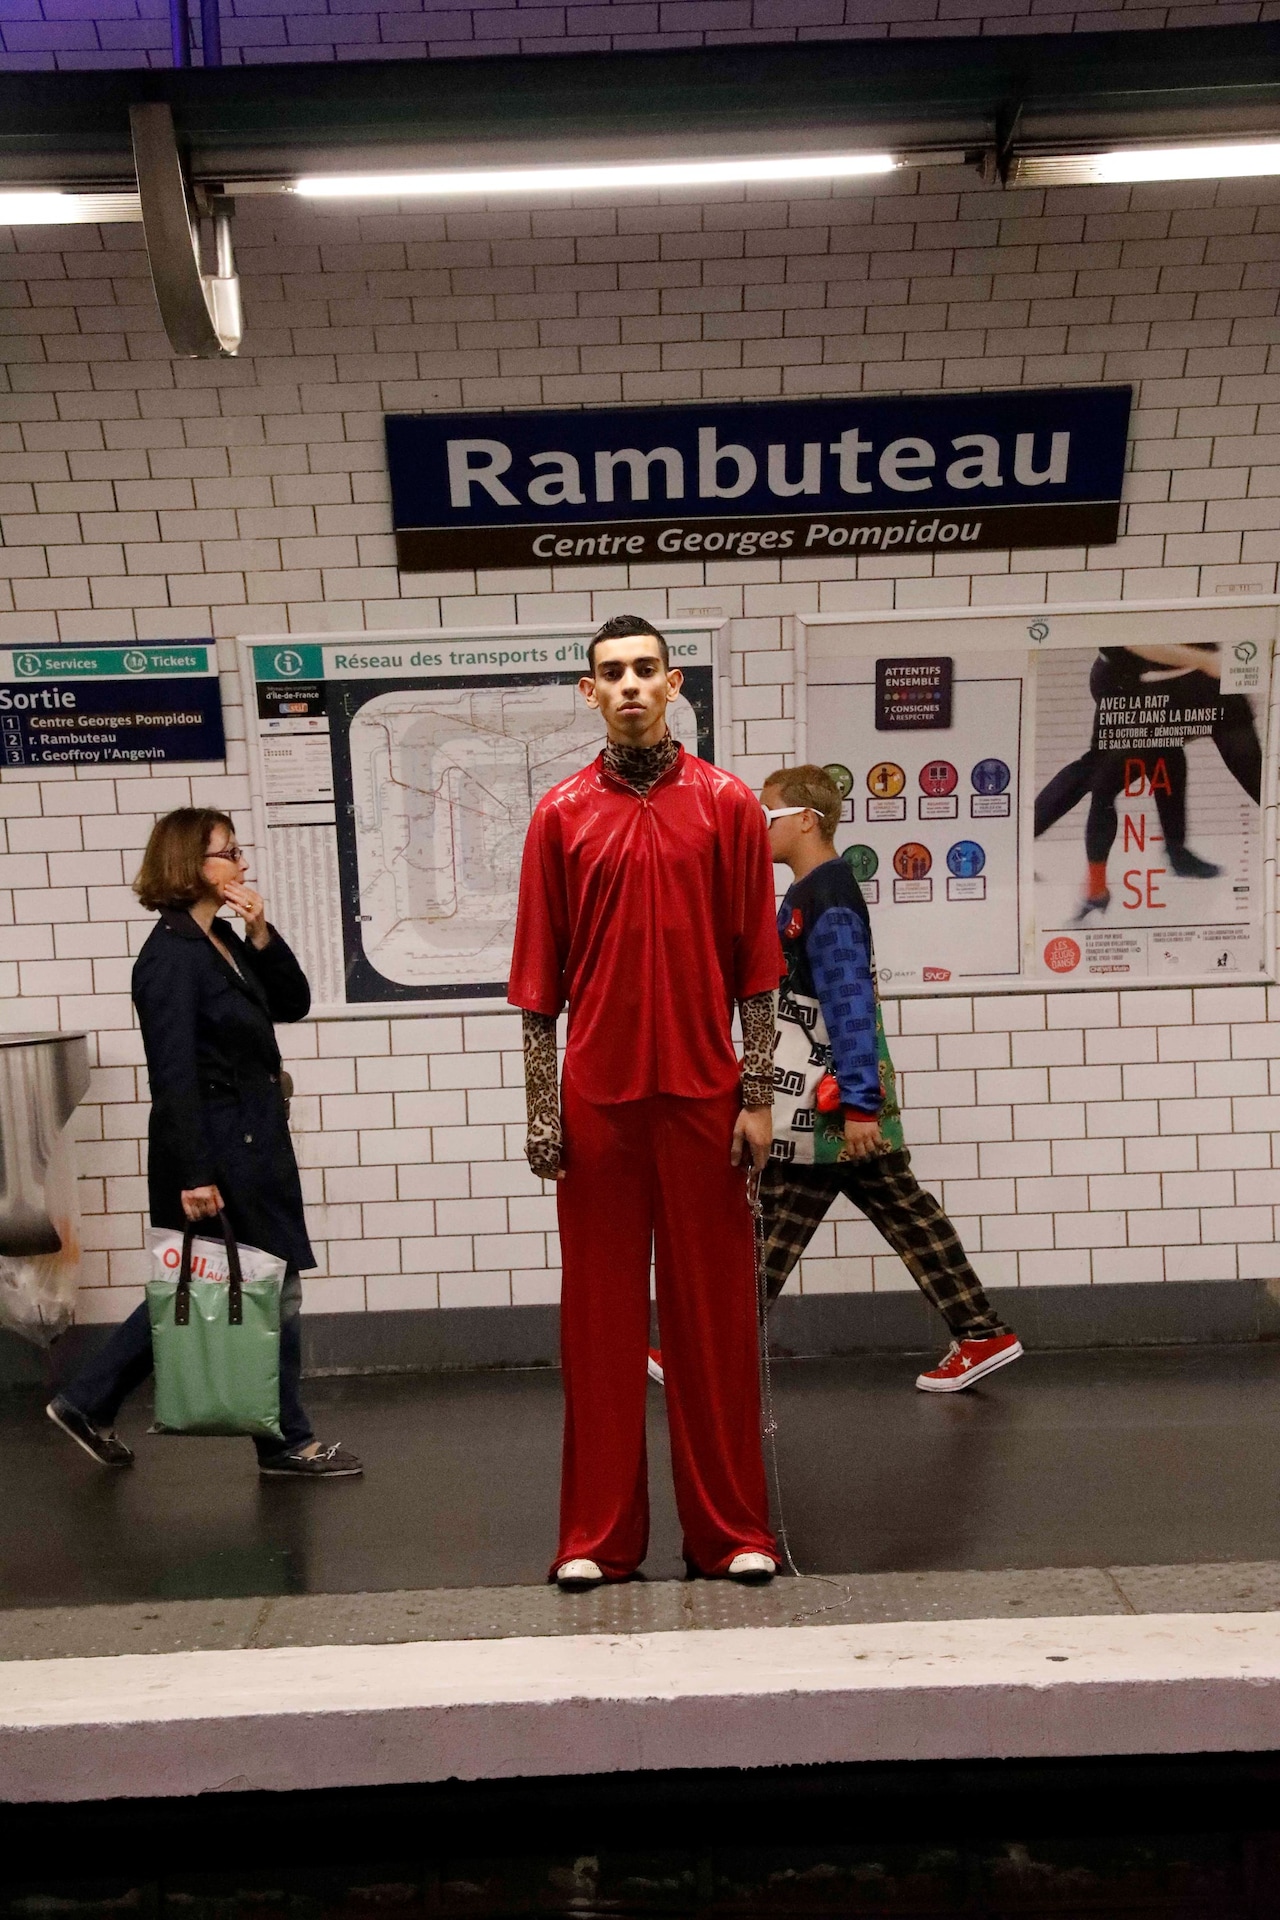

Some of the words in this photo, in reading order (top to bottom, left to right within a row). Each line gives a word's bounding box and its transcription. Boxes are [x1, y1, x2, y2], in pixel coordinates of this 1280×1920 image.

[446, 427, 1070, 508] Rambuteau
[532, 532, 645, 558] Centre
[657, 528, 794, 556] Georges
[805, 519, 982, 550] Pompidou
[45, 658, 98, 670] Services
[151, 654, 197, 667] Tickets
[335, 653, 402, 669] Réseau
[410, 651, 443, 666] des
[449, 648, 548, 667] transports
[885, 666, 941, 676] ATTENTIFS
[885, 677, 940, 687] ENSEMBLE
[0, 687, 77, 710] Sortie
[1099, 696, 1126, 710] AVEC
[1129, 696, 1141, 709] LA
[1145, 695, 1170, 708] RATP
[891, 704, 940, 713] CONSIGNES
[6, 718, 15, 729] 1
[30, 716, 75, 729] Centre
[78, 714, 132, 730] Georges
[135, 712, 202, 729] Pompidou
[1099, 711, 1137, 726] ENTREZ
[1139, 710, 1166, 724] DANS
[1169, 709, 1181, 723] LA
[1184, 708, 1217, 721] DANSE
[9, 735, 19, 746] 2
[29, 735, 38, 745] r.
[40, 732, 117, 745] Rambuteau
[1098, 729, 1108, 739] LE
[1108, 728, 1114, 739] 5
[1115, 727, 1149, 738] OCTOBRE
[1154, 725, 1213, 737] DÉMONSTRATION
[1098, 740, 1108, 750] DE
[1109, 739, 1131, 749] SALSA
[1132, 737, 1184, 749] COLOMBIENNE
[11, 751, 20, 762] 3
[31, 752, 40, 762] r.
[42, 748, 100, 763] Geoffroy
[104, 746, 166, 761] l'Angevin
[1124, 757, 1172, 797] DA
[1123, 869, 1167, 910] SE
[1054, 940, 1068, 951] LES
[1051, 959, 1076, 970] DANSE
[924, 971, 950, 981] SNCF
